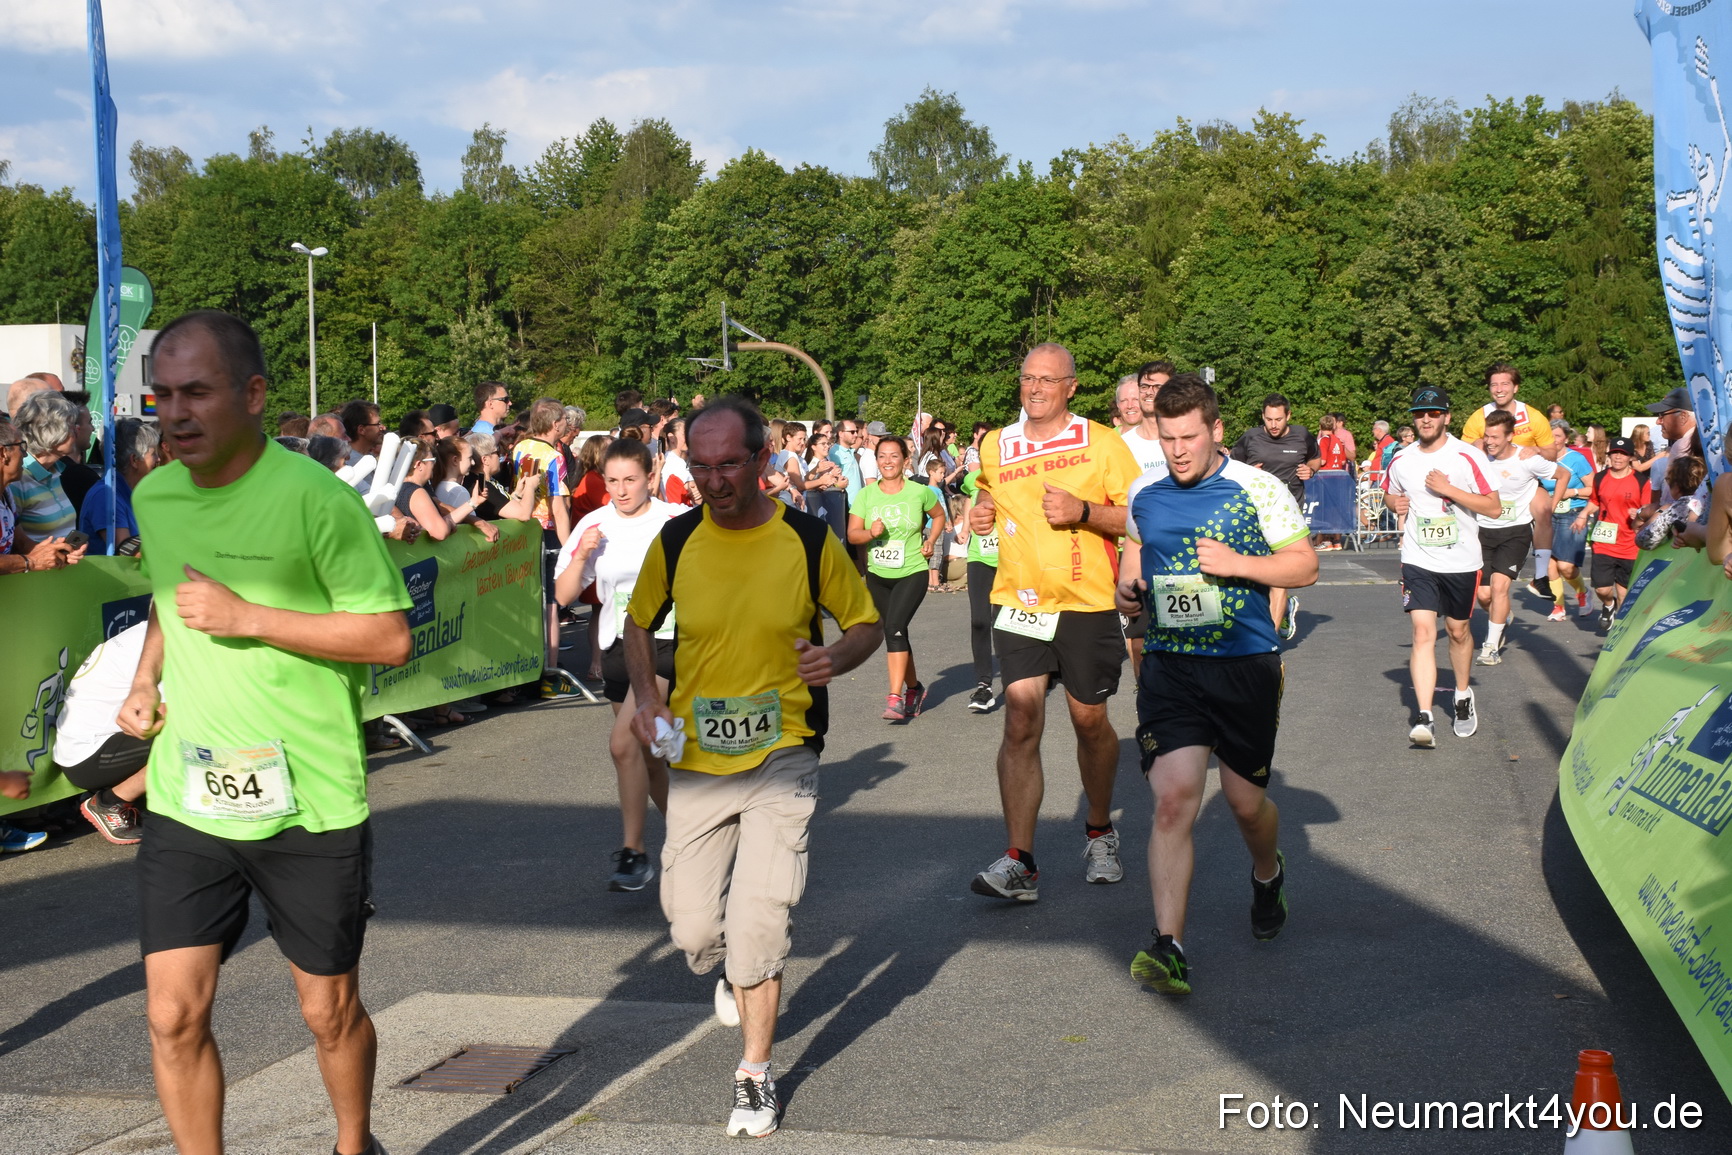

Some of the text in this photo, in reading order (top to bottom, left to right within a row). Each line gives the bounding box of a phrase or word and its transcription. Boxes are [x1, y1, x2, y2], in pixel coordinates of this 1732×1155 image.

[120, 285, 134, 296] OK
[999, 453, 1091, 484] MAX BÖGL
[1144, 460, 1168, 469] HAUP
[982, 536, 1000, 549] 242
[1421, 526, 1452, 538] 1791
[874, 549, 900, 561] 2422
[476, 551, 537, 597] laufen länger!
[1166, 593, 1202, 613] 261
[383, 660, 421, 689] neumarkt
[704, 713, 771, 739] 2014
[738, 736, 759, 745] Martin
[205, 770, 264, 800] 664
[1637, 736, 1732, 831] firmenlau
[1618, 801, 1664, 834] neumarkt
